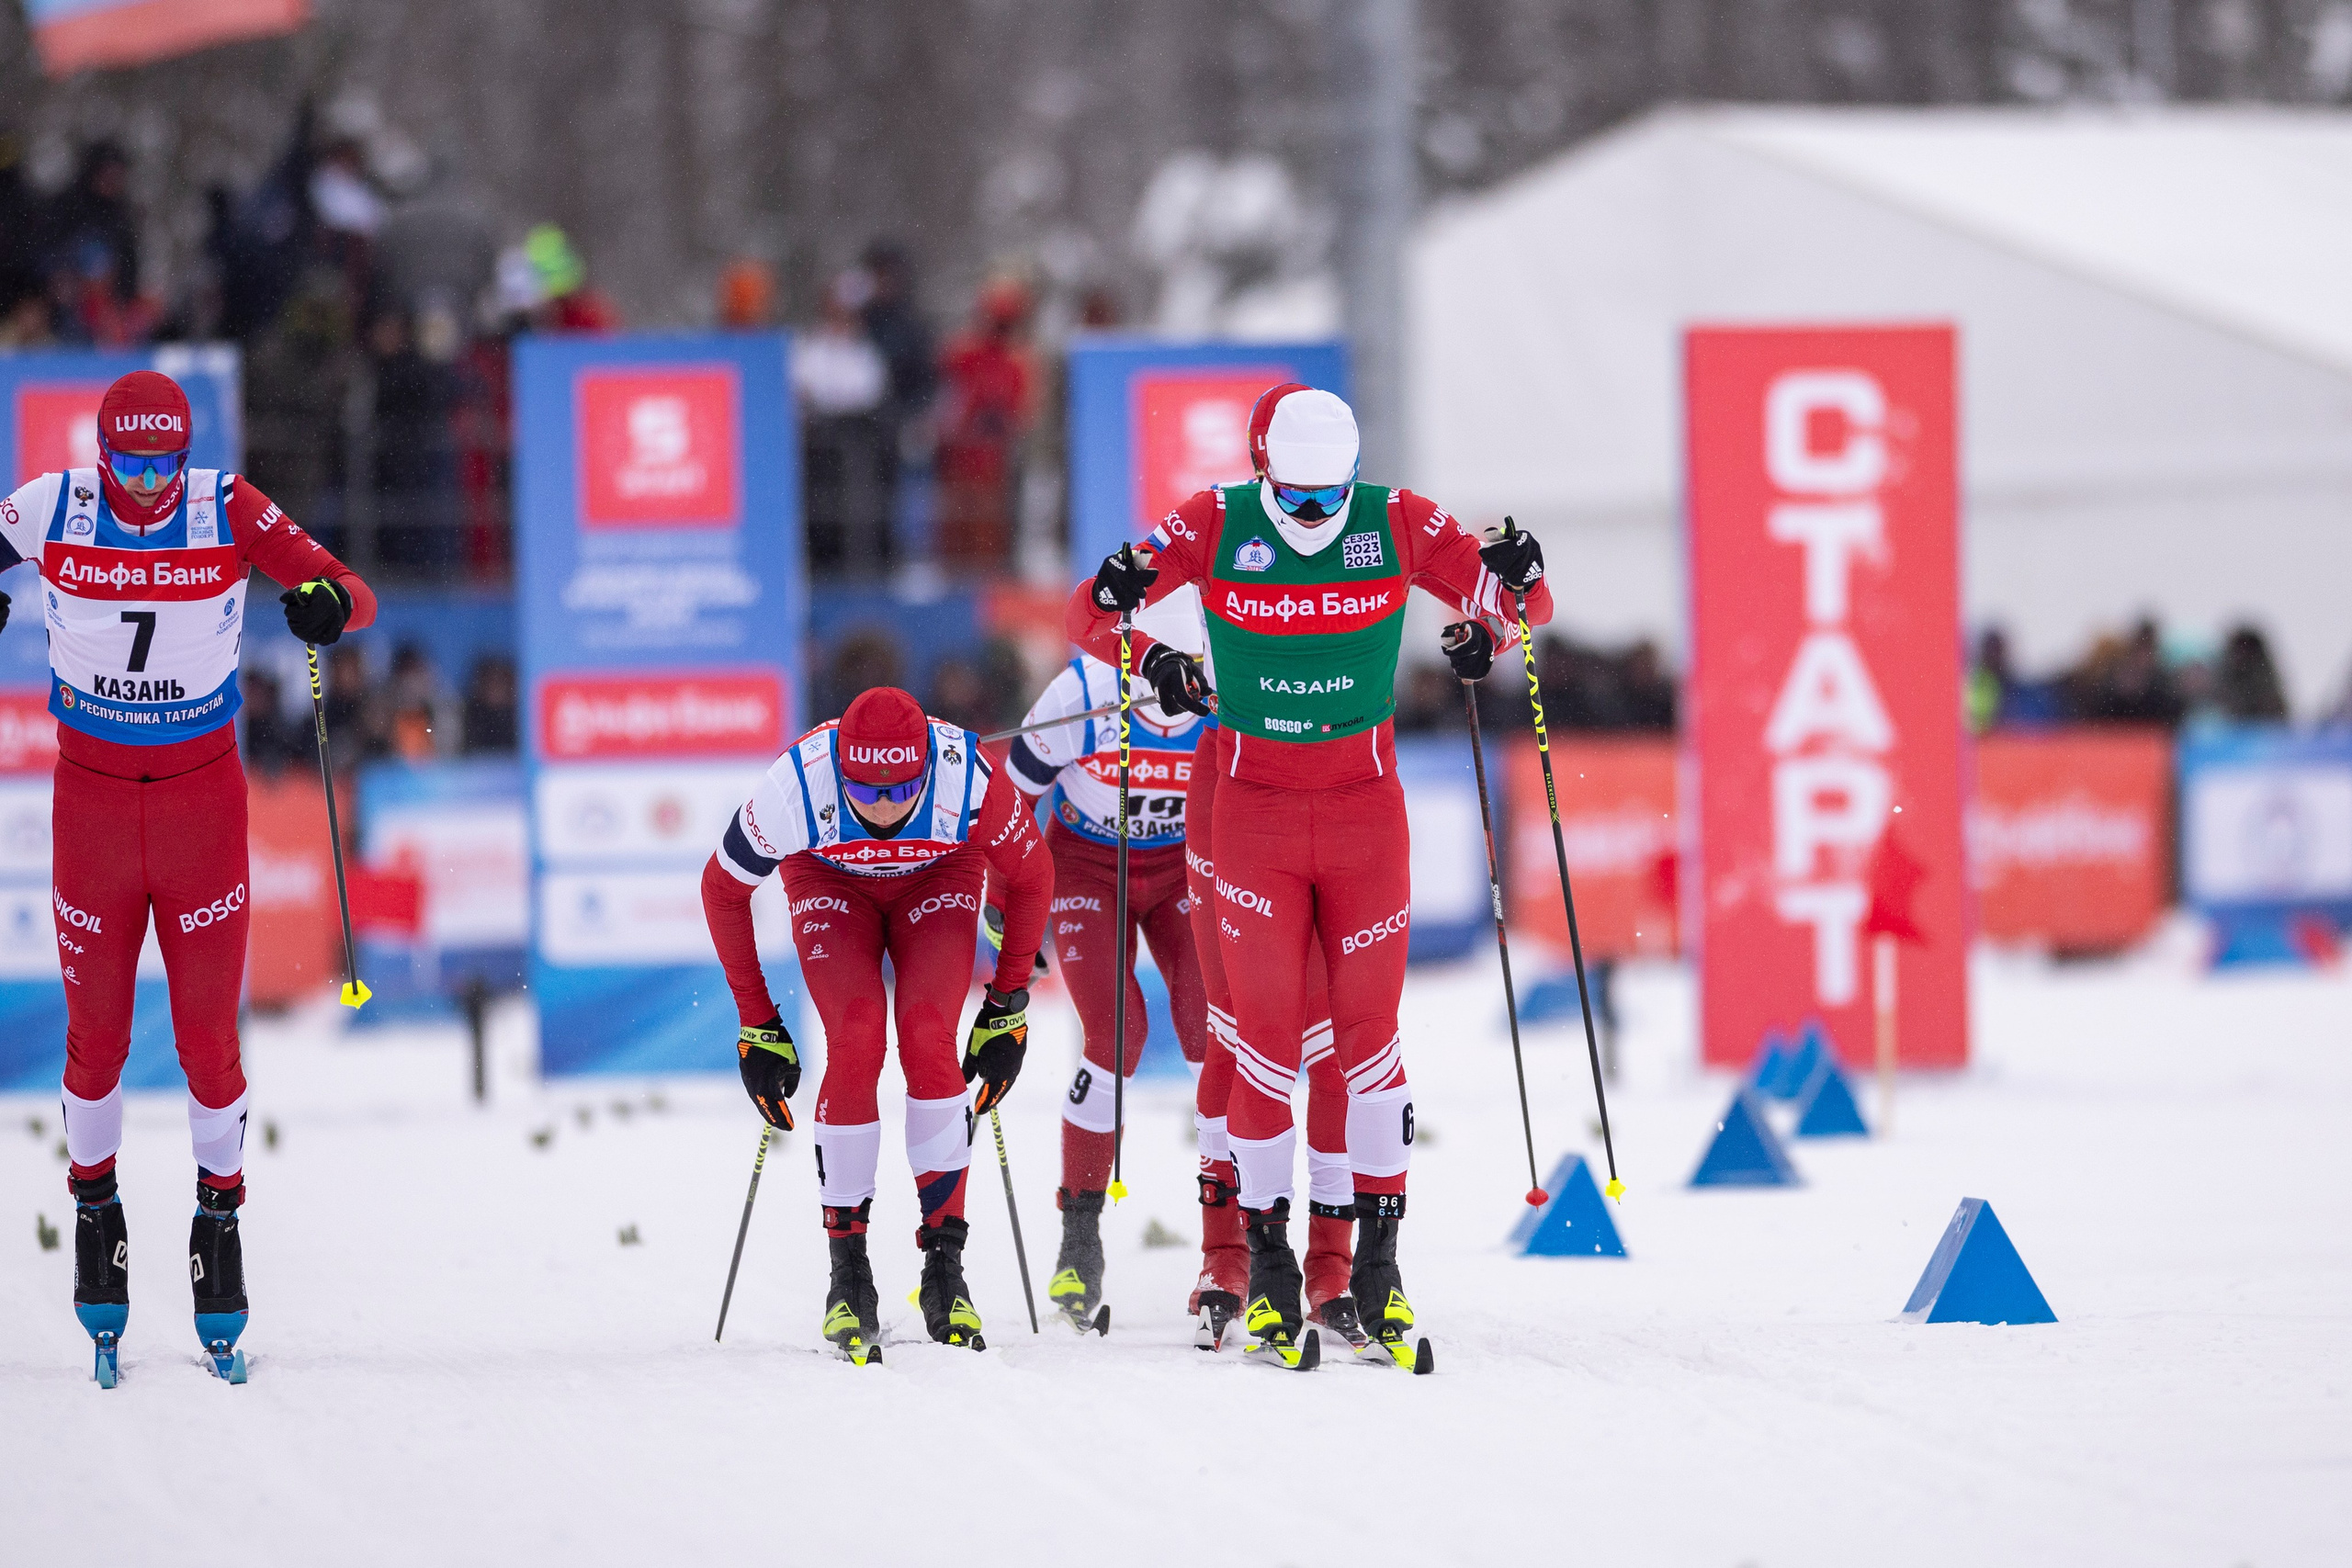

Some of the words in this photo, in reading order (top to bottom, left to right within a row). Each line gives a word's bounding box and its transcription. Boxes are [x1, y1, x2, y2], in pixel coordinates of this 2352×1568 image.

[115, 413, 183, 432] LUKOIL
[1343, 533, 1378, 544] СЕЗОН
[1344, 541, 1379, 555] 2023
[1108, 557, 1126, 571] adidas
[1345, 554, 1382, 568] 2024
[59, 557, 147, 591] Альфа
[153, 562, 222, 586] Банк
[1226, 591, 1316, 623] Альфа
[1322, 591, 1391, 615] Банк
[120, 611, 156, 672] 7
[94, 674, 186, 702] КАЗАНЬ
[1260, 675, 1354, 694] КАЗАНЬ
[1764, 372, 1894, 1006] СТАРТ
[79, 699, 161, 725] РЕСПУБЛИКА
[164, 692, 224, 723] ТАТАРСТАН
[1264, 716, 1302, 734] BOSCO
[1330, 716, 1364, 731] ЛУКОЙЛ
[849, 745, 919, 764] LUKOIL
[1085, 759, 1169, 782] Алфа
[1545, 773, 1555, 808] BLACKCODE
[746, 798, 776, 854] BOSCO
[791, 897, 850, 917] LUKOIL
[1216, 875, 1273, 918] LUKOIL
[54, 886, 102, 933] LUKOIL
[179, 883, 245, 933] BOSCO
[908, 893, 977, 925] BOSCO
[803, 920, 831, 934] En+
[1058, 920, 1083, 935] En+
[1221, 917, 1240, 938] En+
[1341, 909, 1408, 955] BOSCO
[59, 932, 85, 954] En+
